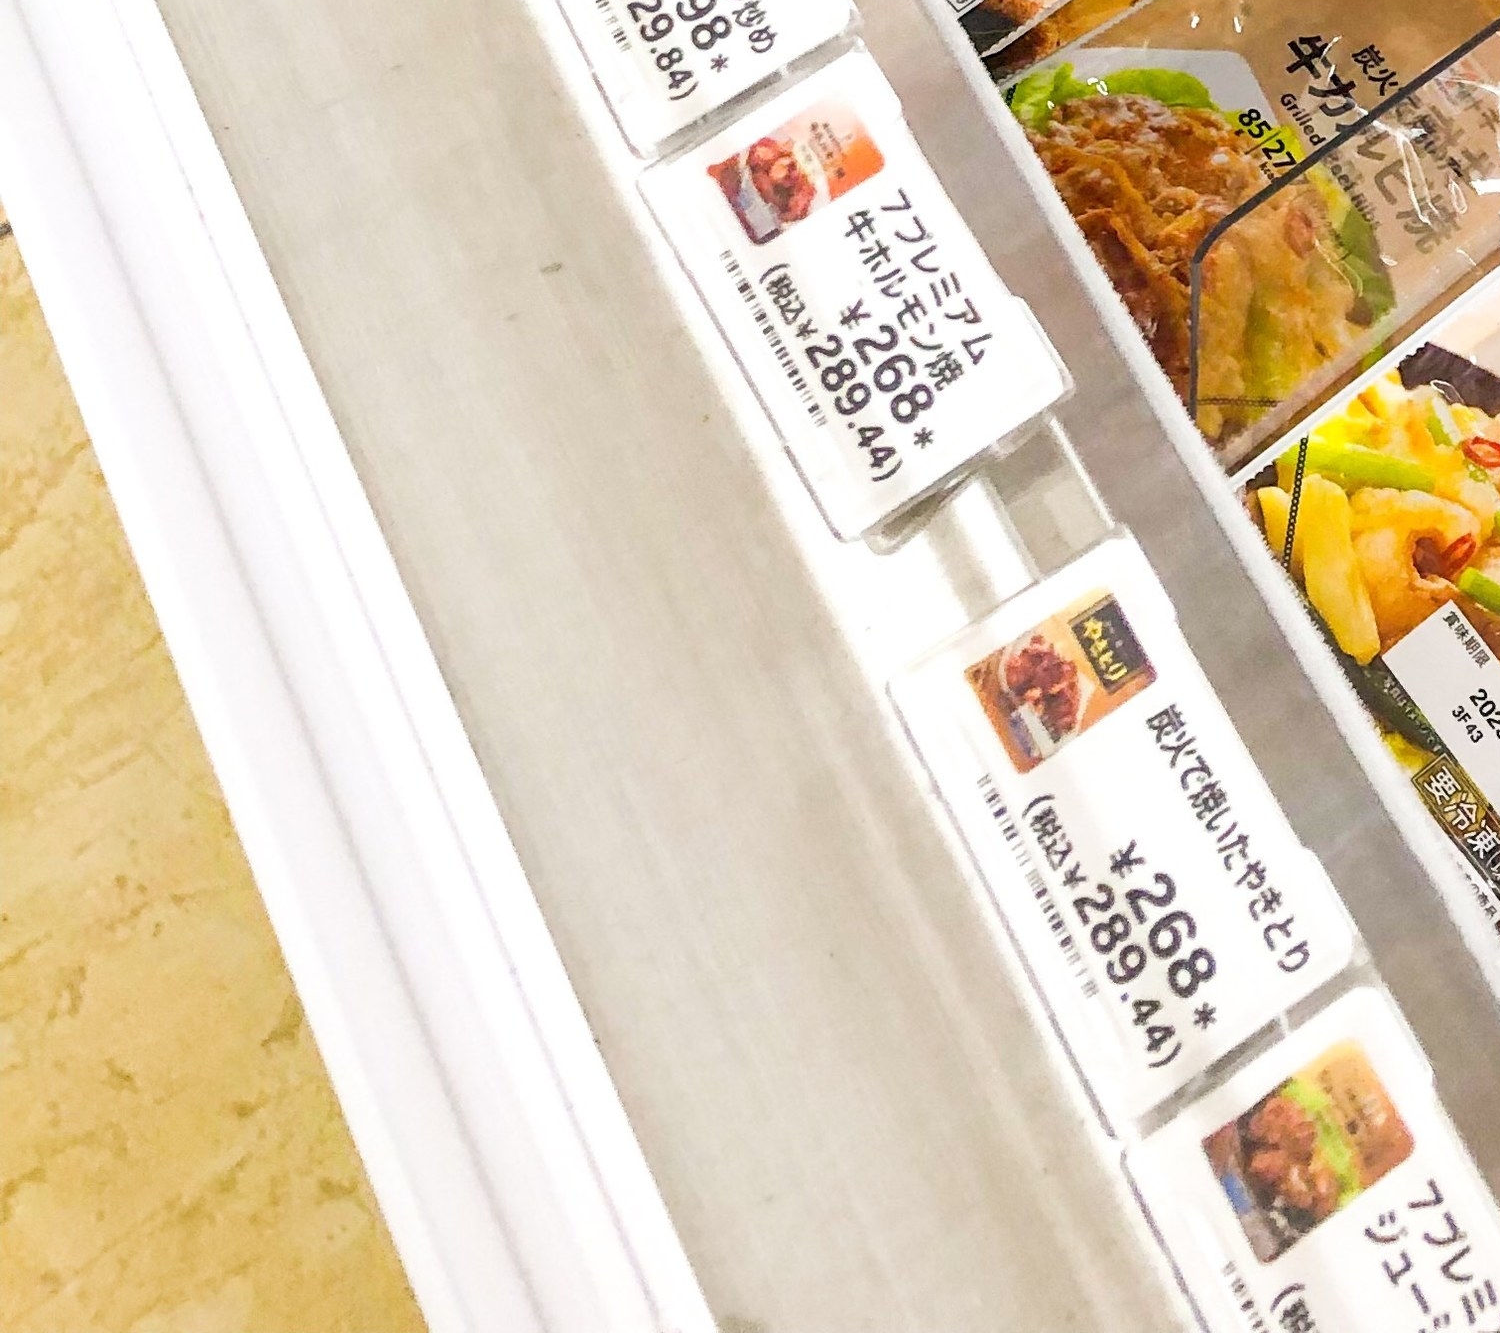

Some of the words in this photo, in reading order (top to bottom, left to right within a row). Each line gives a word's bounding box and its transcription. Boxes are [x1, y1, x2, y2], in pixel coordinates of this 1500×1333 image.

[1234, 107, 1266, 139] 85
[1278, 92, 1327, 148] Grilled
[844, 209, 965, 392] 牛ホルモン焼
[881, 187, 994, 366] 7プレミアム
[758, 261, 904, 483] (税込¥289.44)
[1440, 607, 1492, 670] 賞味期限
[1448, 703, 1485, 746] 3F43
[1146, 701, 1311, 974] 炭火で焼いたやきとり
[1022, 793, 1184, 1070] (税込¥289.44)
